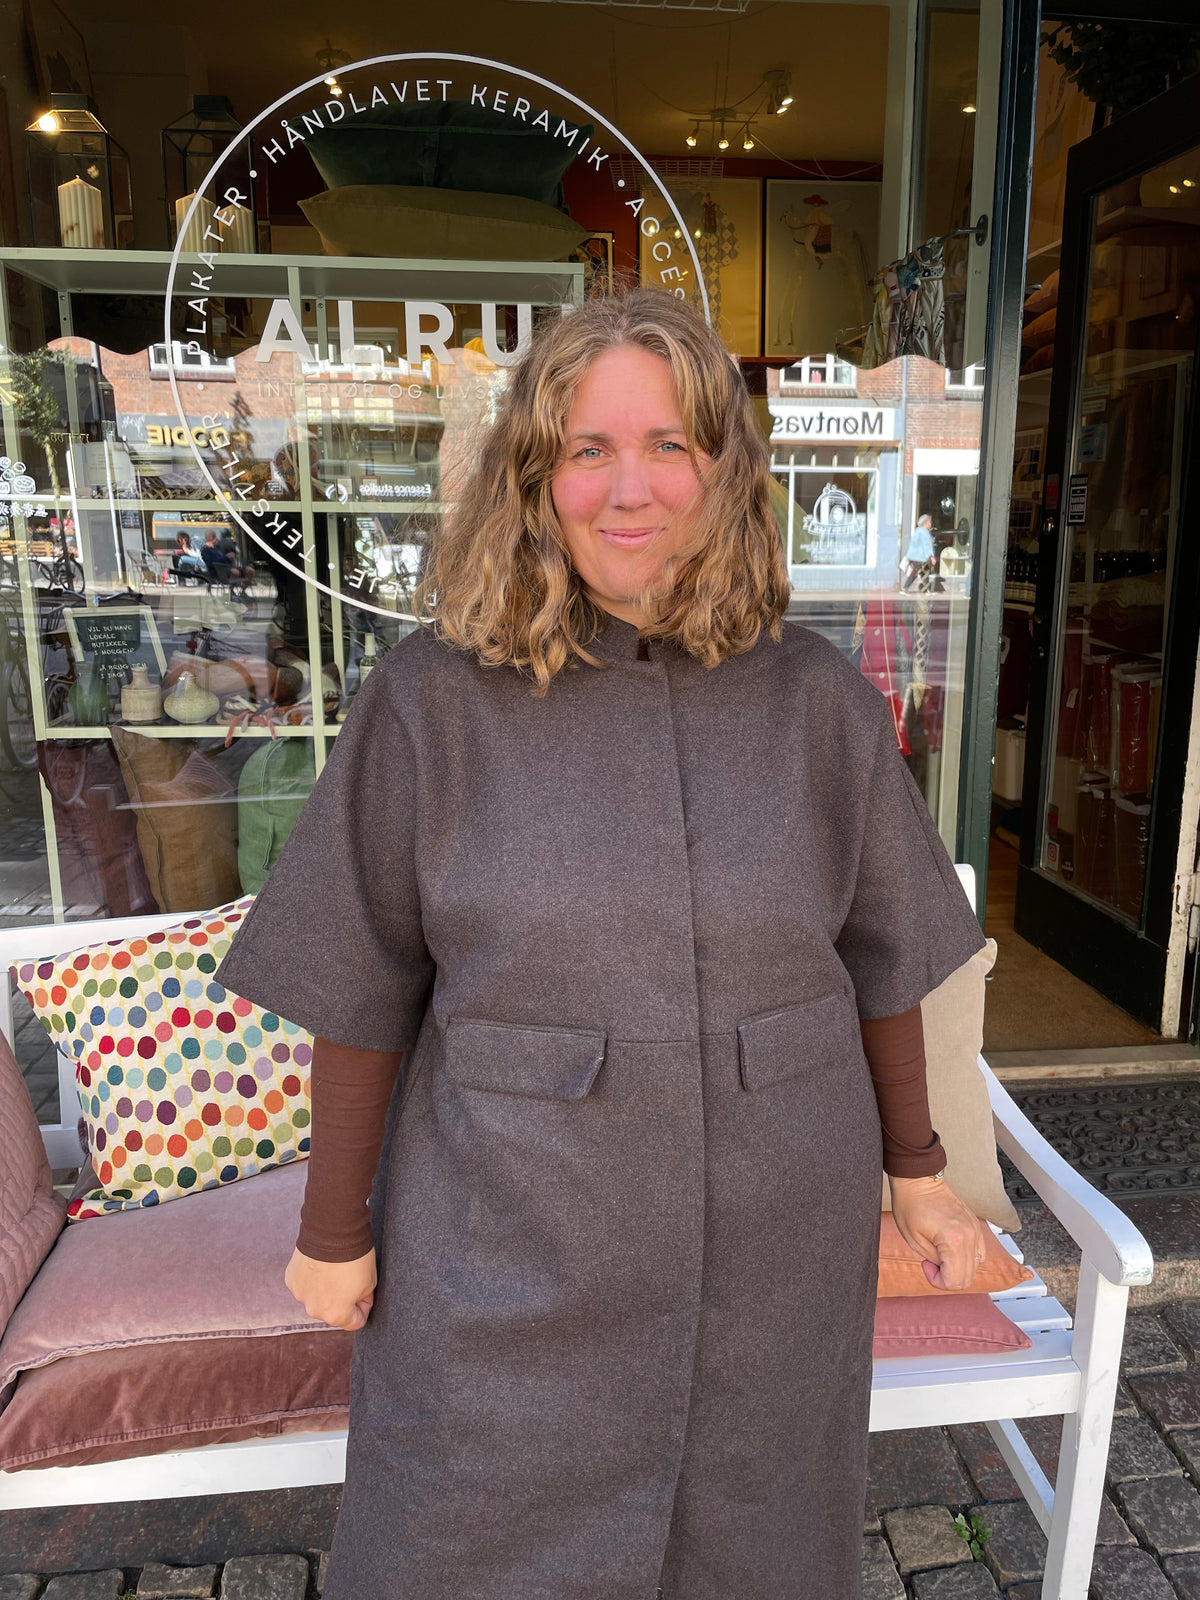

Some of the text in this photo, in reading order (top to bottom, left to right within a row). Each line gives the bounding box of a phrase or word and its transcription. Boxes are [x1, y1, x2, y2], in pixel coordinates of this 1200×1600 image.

[262, 79, 609, 171] HÅNDLAVET KERAMIK
[186, 187, 247, 355] PLAKATER
[255, 299, 576, 367] ALRU
[257, 383, 374, 398] INTERIØR
[388, 383, 423, 399] OG
[202, 413, 316, 563] TEKSTILER
